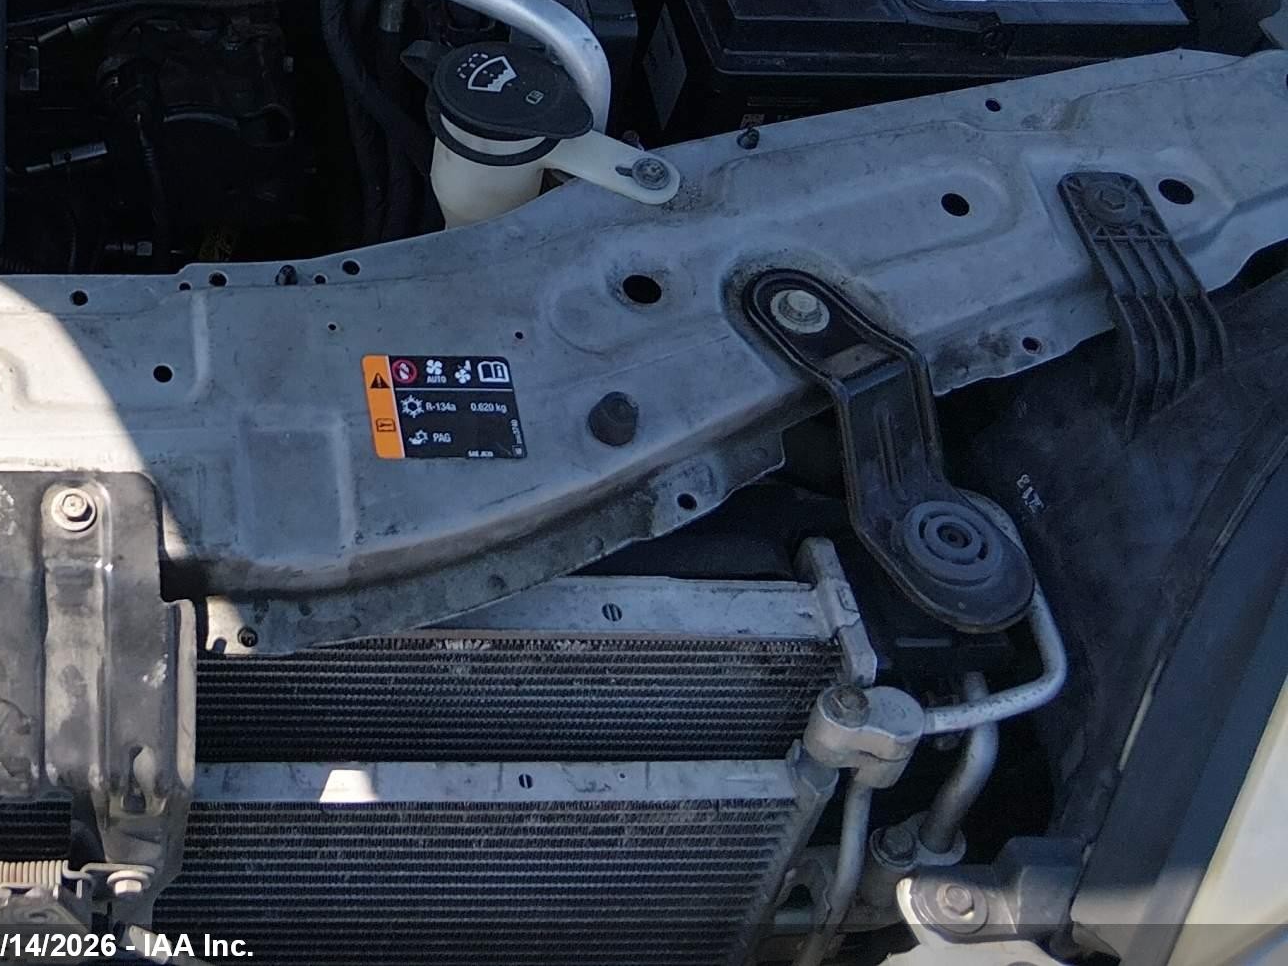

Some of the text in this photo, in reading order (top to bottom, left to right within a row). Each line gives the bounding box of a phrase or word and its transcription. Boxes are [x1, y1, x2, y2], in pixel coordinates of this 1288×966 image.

[426, 375, 447, 384] AUTO
[425, 402, 507, 414] R-134a 0.620 kg
[432, 432, 451, 443] PAG
